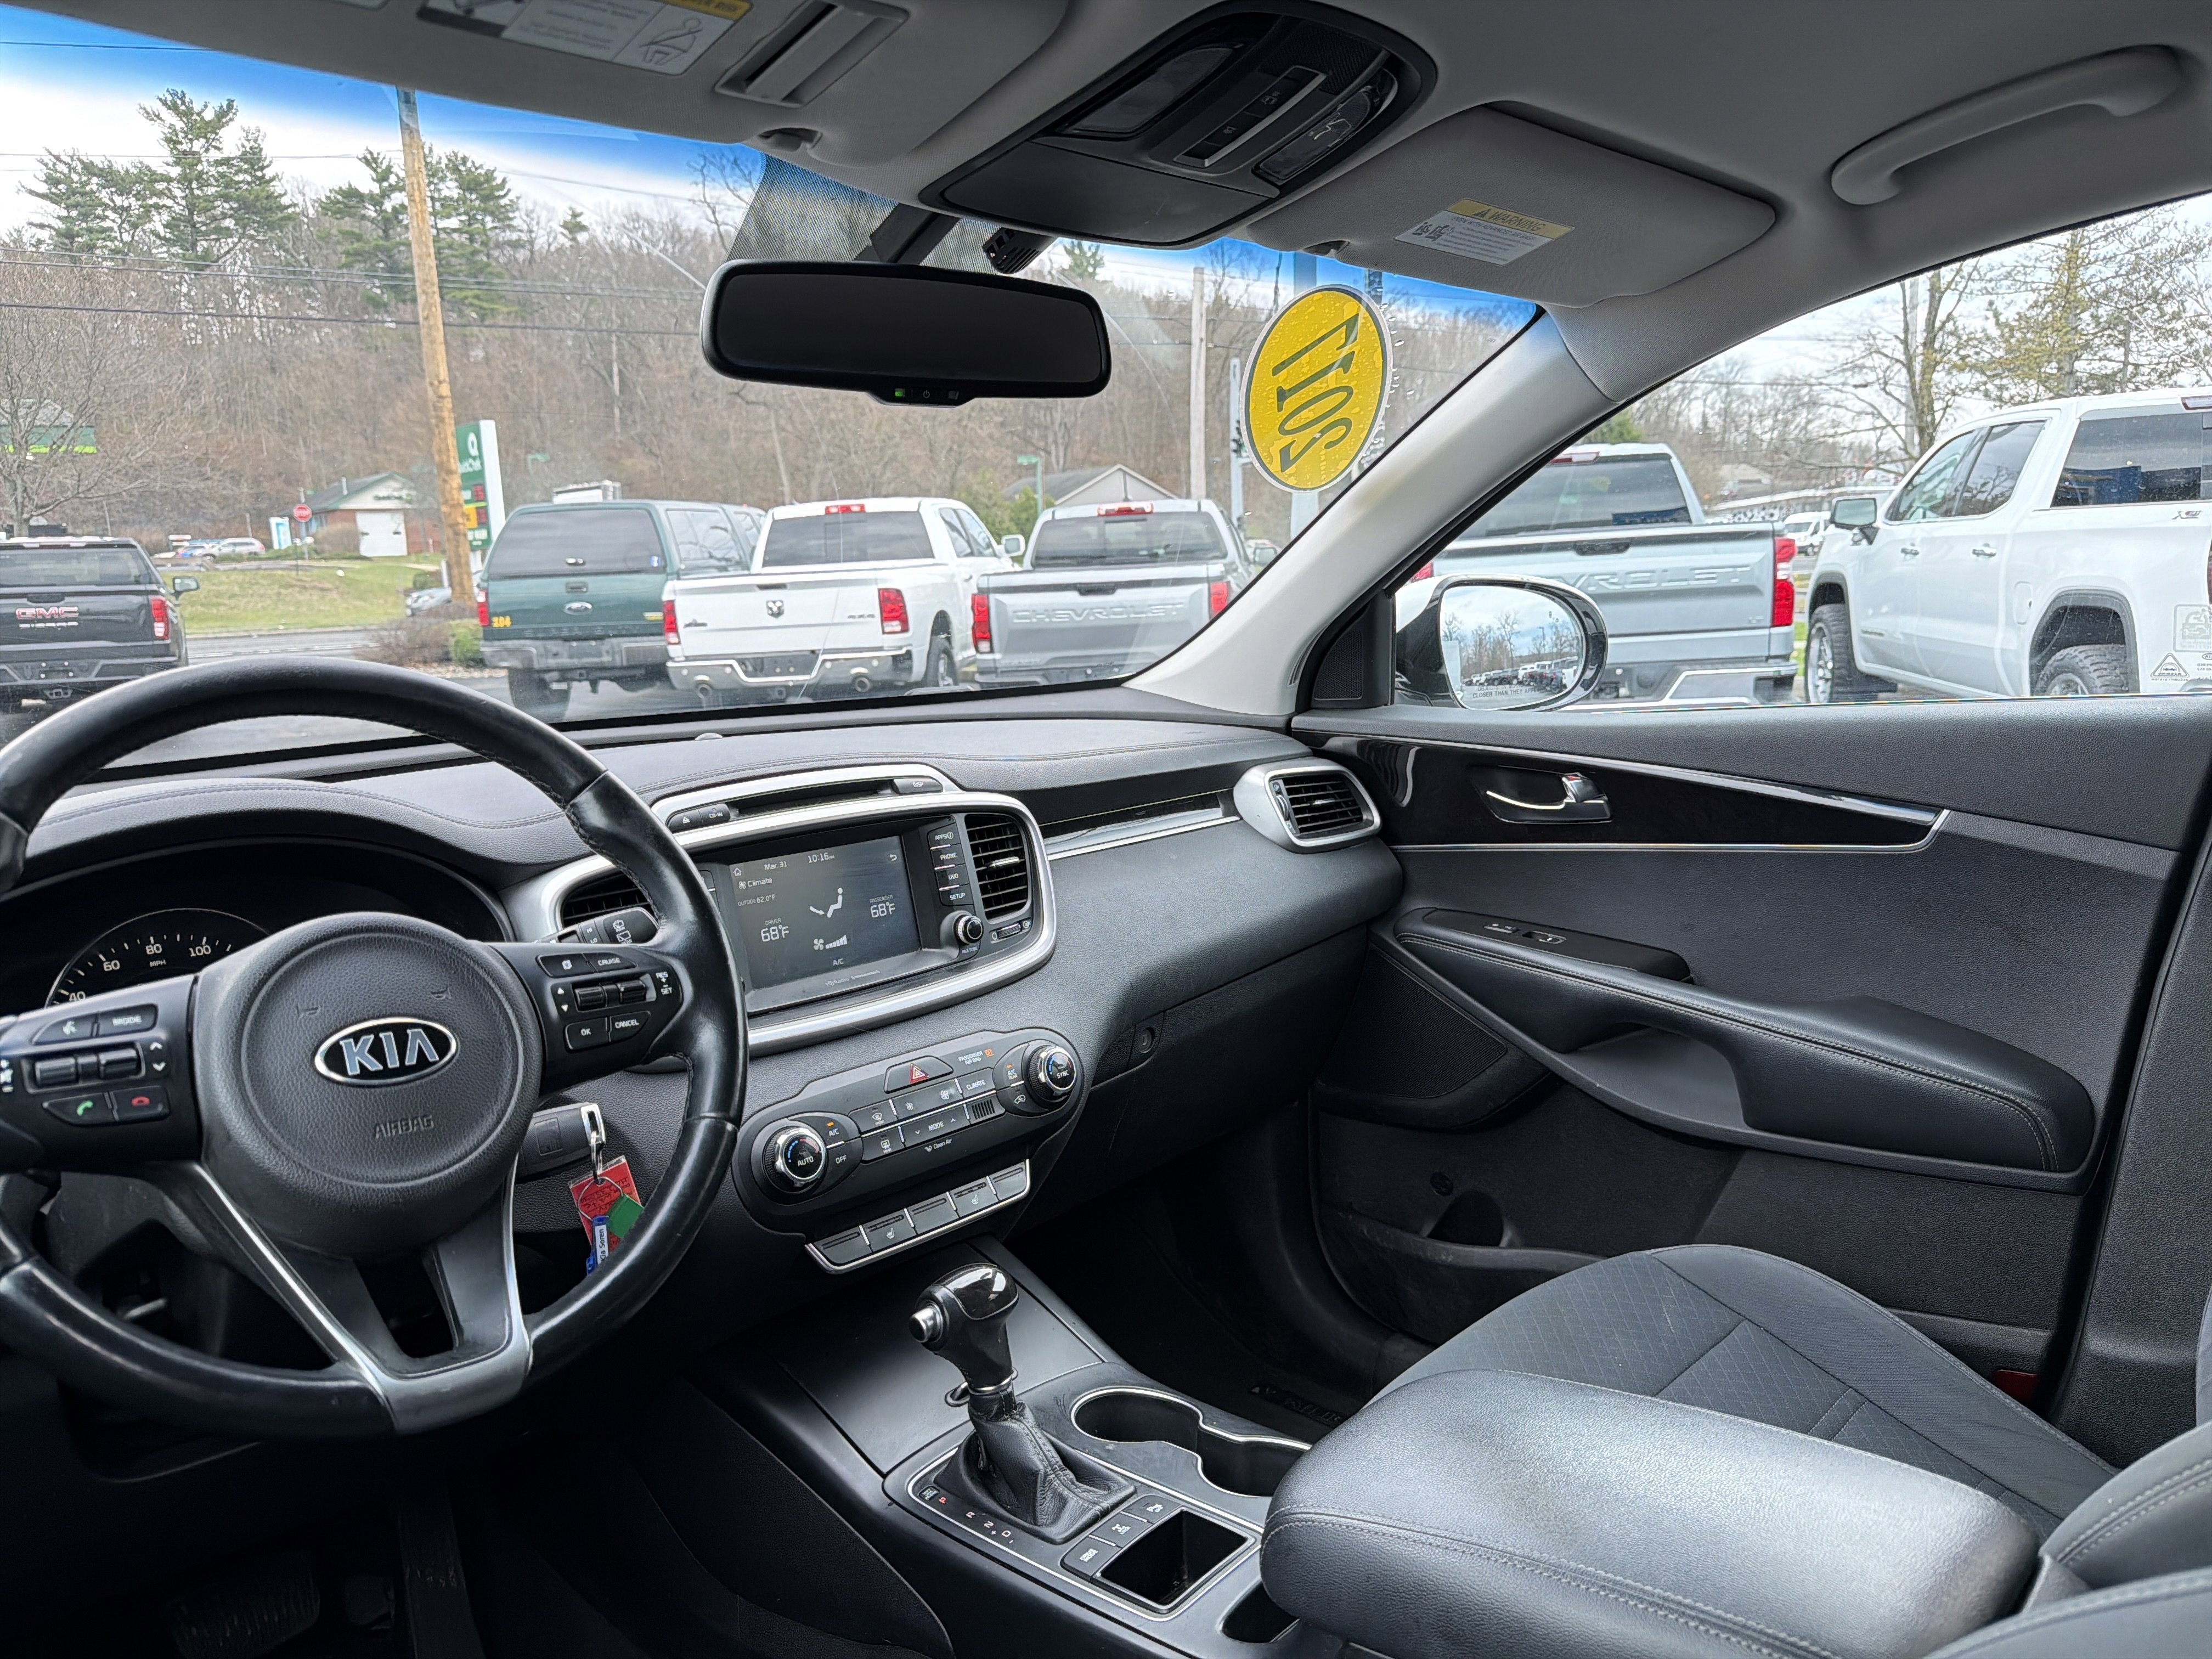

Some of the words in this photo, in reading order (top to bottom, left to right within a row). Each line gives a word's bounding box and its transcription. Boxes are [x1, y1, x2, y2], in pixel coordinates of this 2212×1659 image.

[1488, 211, 1546, 231] WARNING
[1481, 223, 1512, 235] ADVANCED
[1560, 565, 1751, 591] VROLET
[15, 606, 79, 620] GMC
[1013, 602, 1184, 623] CHEVROLET
[807, 853, 829, 864] 10:16
[940, 852, 957, 860] PHONE
[779, 860, 788, 869] 31
[747, 877, 773, 888] Climate
[737, 898, 756, 907] OUTSIDE
[756, 894, 776, 904] 62.0°F
[869, 894, 894, 904] PASSENGER
[949, 892, 966, 901] SETUP
[764, 918, 782, 926] DRIVER
[145, 943, 163, 955] 80
[189, 945, 212, 957] 100
[103, 960, 121, 972] 60
[149, 959, 166, 967] MPH
[597, 957, 621, 966] CRUISE
[833, 958, 844, 966] A/C
[661, 986, 673, 995] SET
[69, 991, 86, 1003] 40
[614, 1019, 640, 1029] CANCEL
[580, 1028, 592, 1036] OK
[339, 1029, 439, 1076] KIA
[957, 1051, 984, 1062] PASSENGER
[375, 1114, 435, 1139] AIRBAG
[928, 1121, 945, 1131] MODE
[828, 1128, 840, 1137] A/C
[933, 1141, 946, 1150] Clean
[797, 1155, 815, 1167] AUTO
[835, 1154, 848, 1164] OFF
